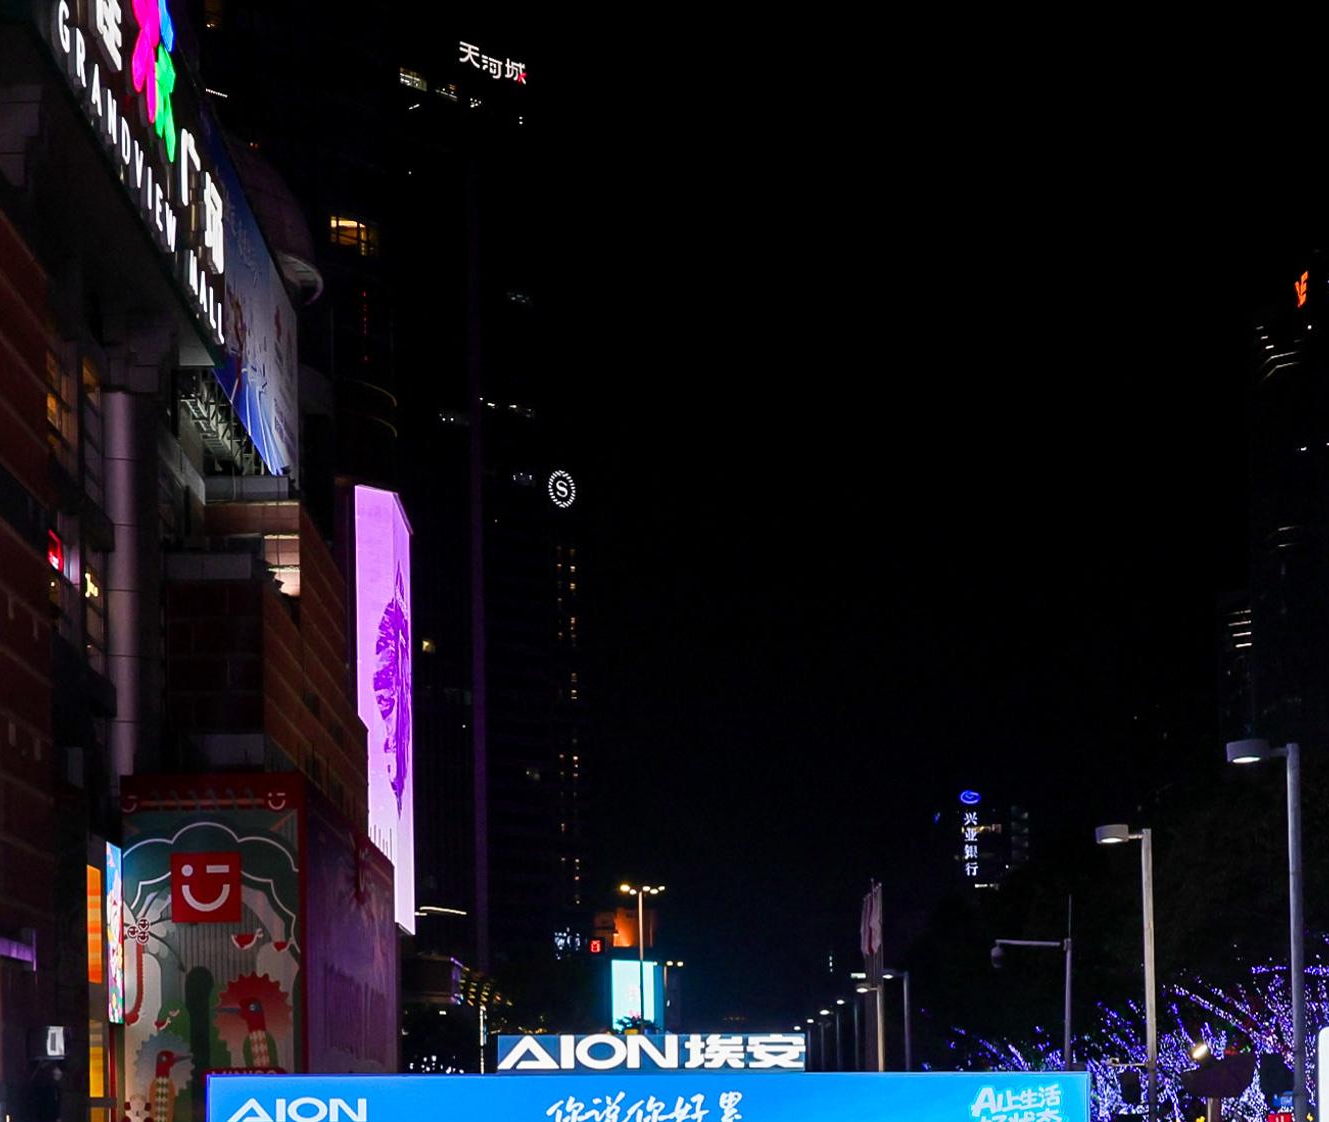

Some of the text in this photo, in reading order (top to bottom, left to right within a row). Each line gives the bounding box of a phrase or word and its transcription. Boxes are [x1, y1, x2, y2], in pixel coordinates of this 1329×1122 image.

[458, 40, 527, 85] 天河城
[58, 0, 224, 344] GRANDVIEW MALL
[963, 812, 979, 876] 兴业银行
